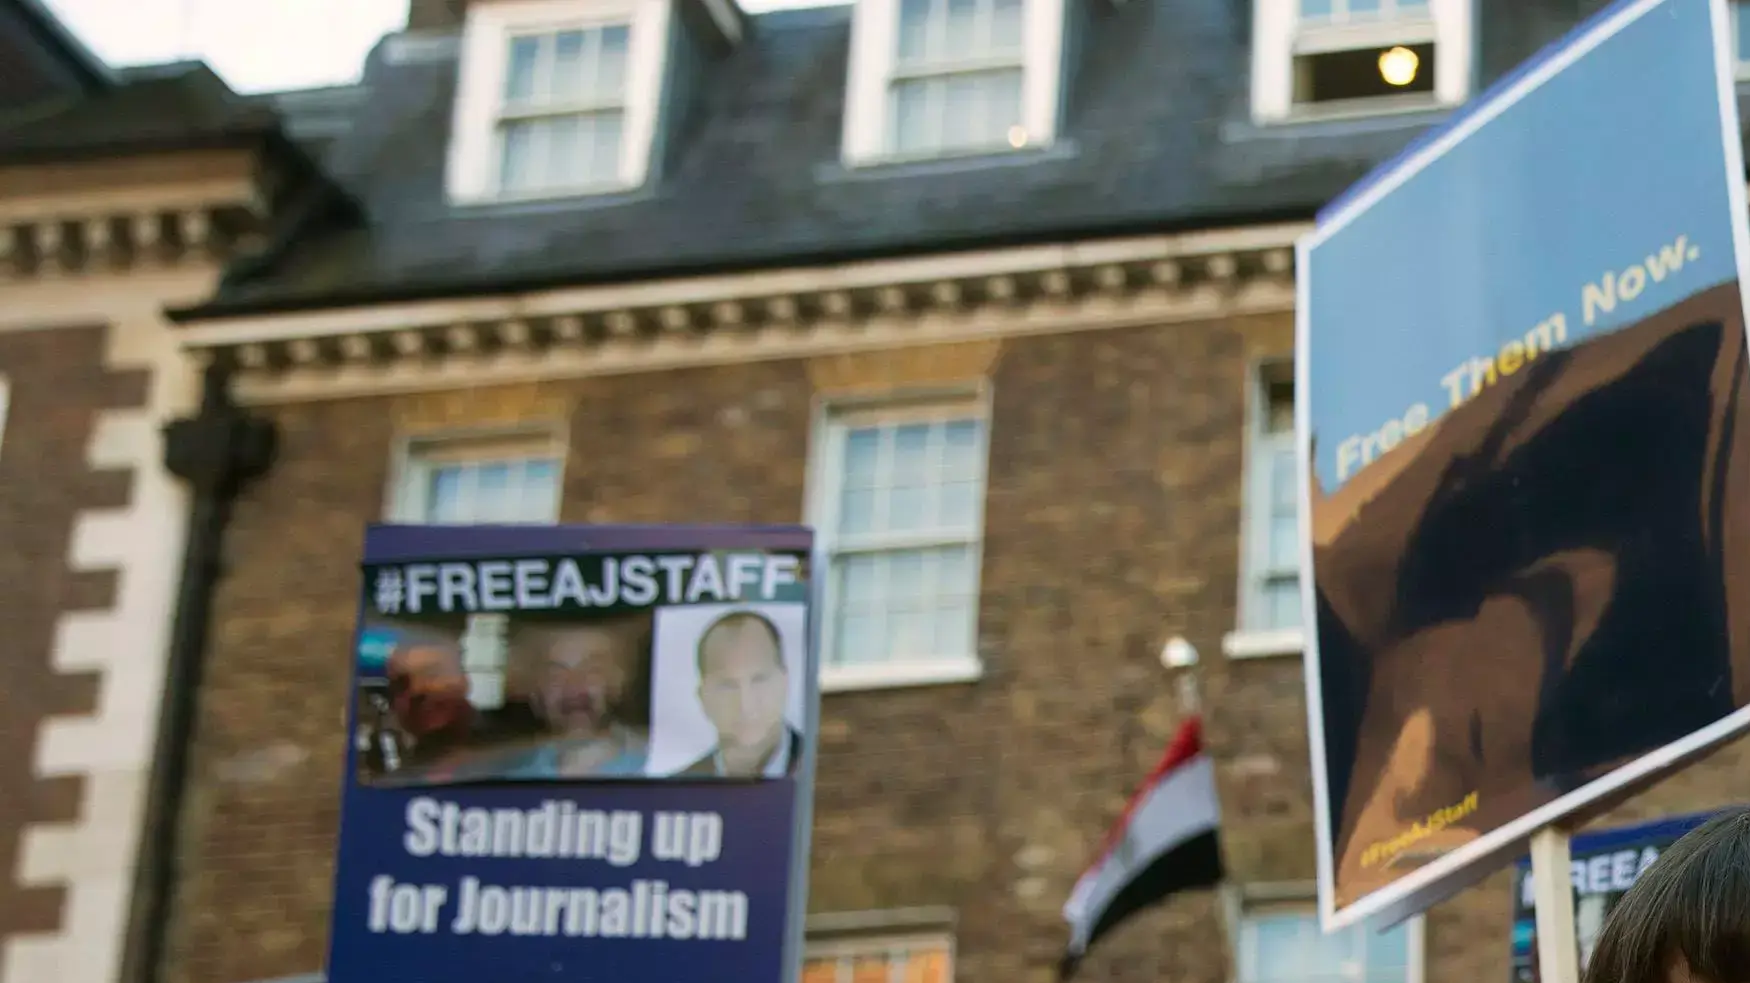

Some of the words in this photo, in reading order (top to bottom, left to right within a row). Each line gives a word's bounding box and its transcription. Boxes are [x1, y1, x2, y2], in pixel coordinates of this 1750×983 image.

[1336, 403, 1429, 482] Free
[1440, 312, 1568, 410] Them
[1581, 235, 1700, 326] Now.
[375, 553, 800, 614] #FREEAJSTAFF
[404, 797, 643, 864] Standing
[652, 808, 723, 867] up
[366, 873, 447, 935] for
[453, 877, 749, 940] Journalism
